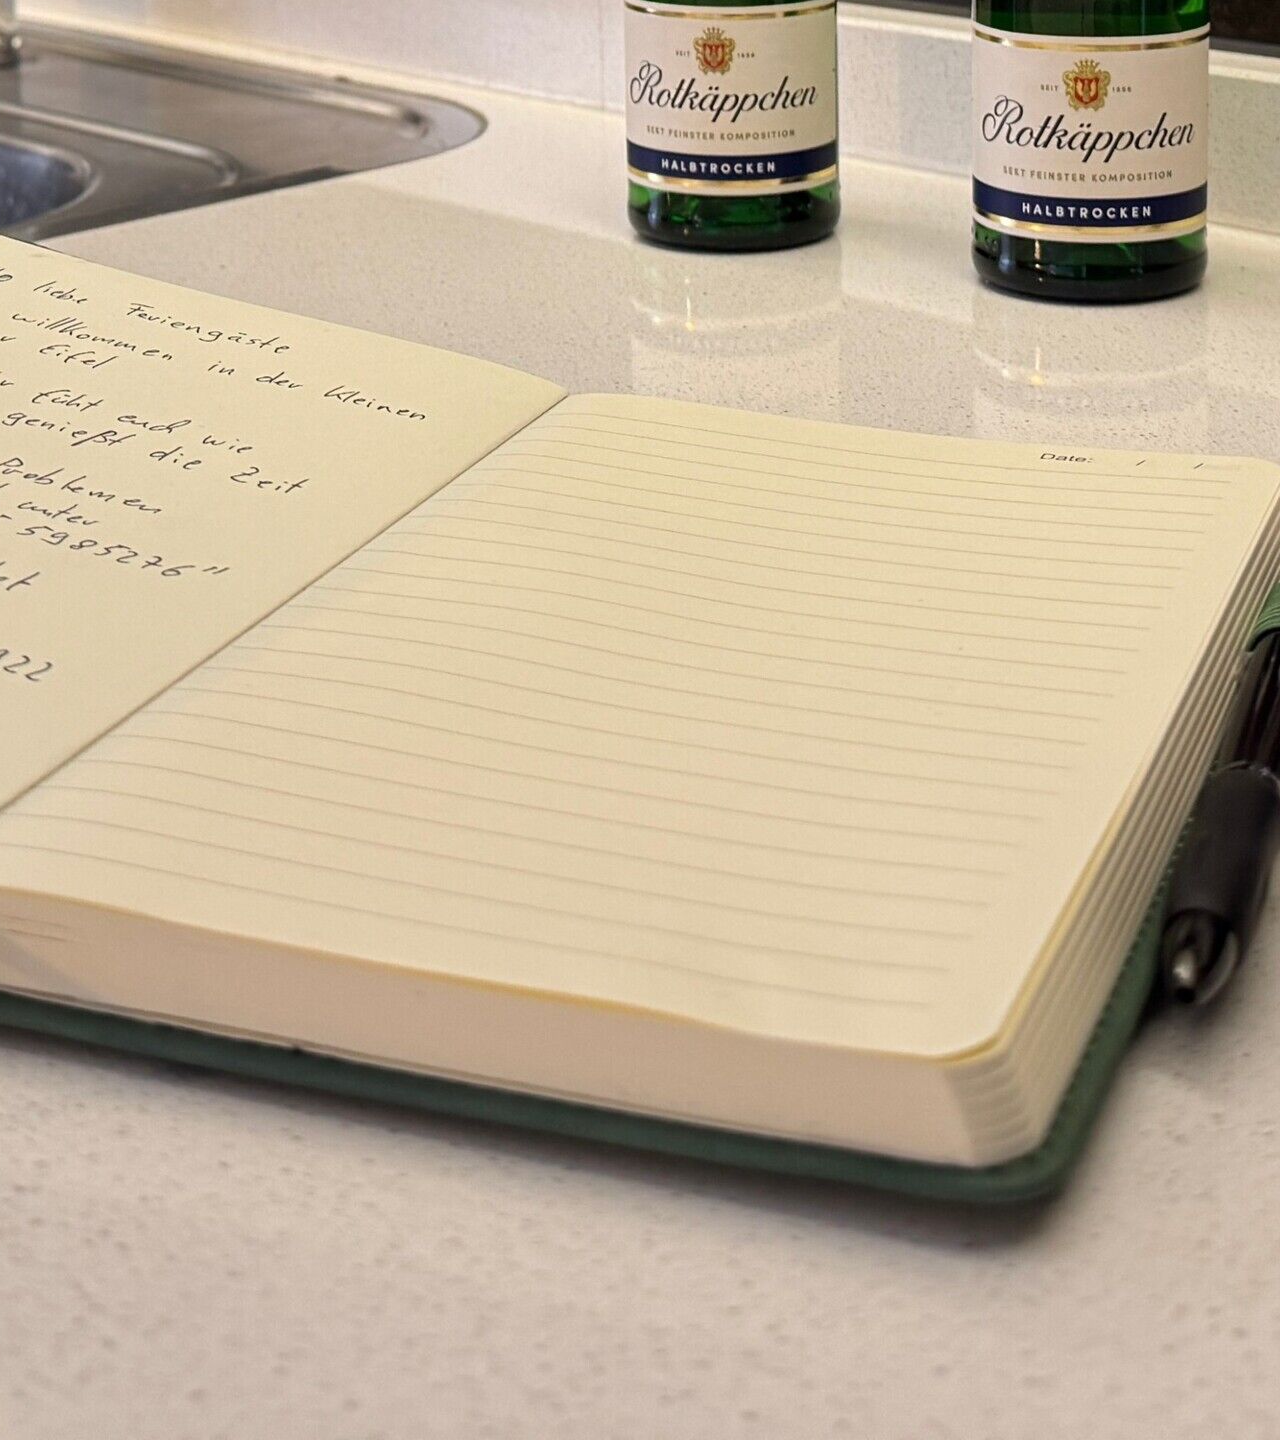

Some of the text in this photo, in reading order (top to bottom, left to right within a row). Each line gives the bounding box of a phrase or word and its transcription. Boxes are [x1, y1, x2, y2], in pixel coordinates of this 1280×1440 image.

[629, 59, 817, 123] Rotkäppchen
[646, 124, 796, 141] SEKT FEINSTER KOMPOSITION
[982, 95, 1195, 163] Rotkäppchen
[661, 158, 776, 173] HALBTROCKEN
[1003, 165, 1173, 183] SEKT FEINSTER KOMPOSITION
[1022, 202, 1152, 220] HALBTROCKEN
[125, 303, 291, 354] Feriengäste
[12, 313, 173, 361] willkommen
[207, 361, 235, 376] in
[256, 371, 304, 390] der
[39, 344, 119, 370] Eifel
[117, 413, 192, 434] euch
[202, 435, 254, 454] wie
[1, 412, 136, 447] genießt
[148, 446, 203, 470] die
[230, 466, 310, 494] Zeit
[1040, 453, 1095, 464] Date:
[17, 500, 100, 527] unter
